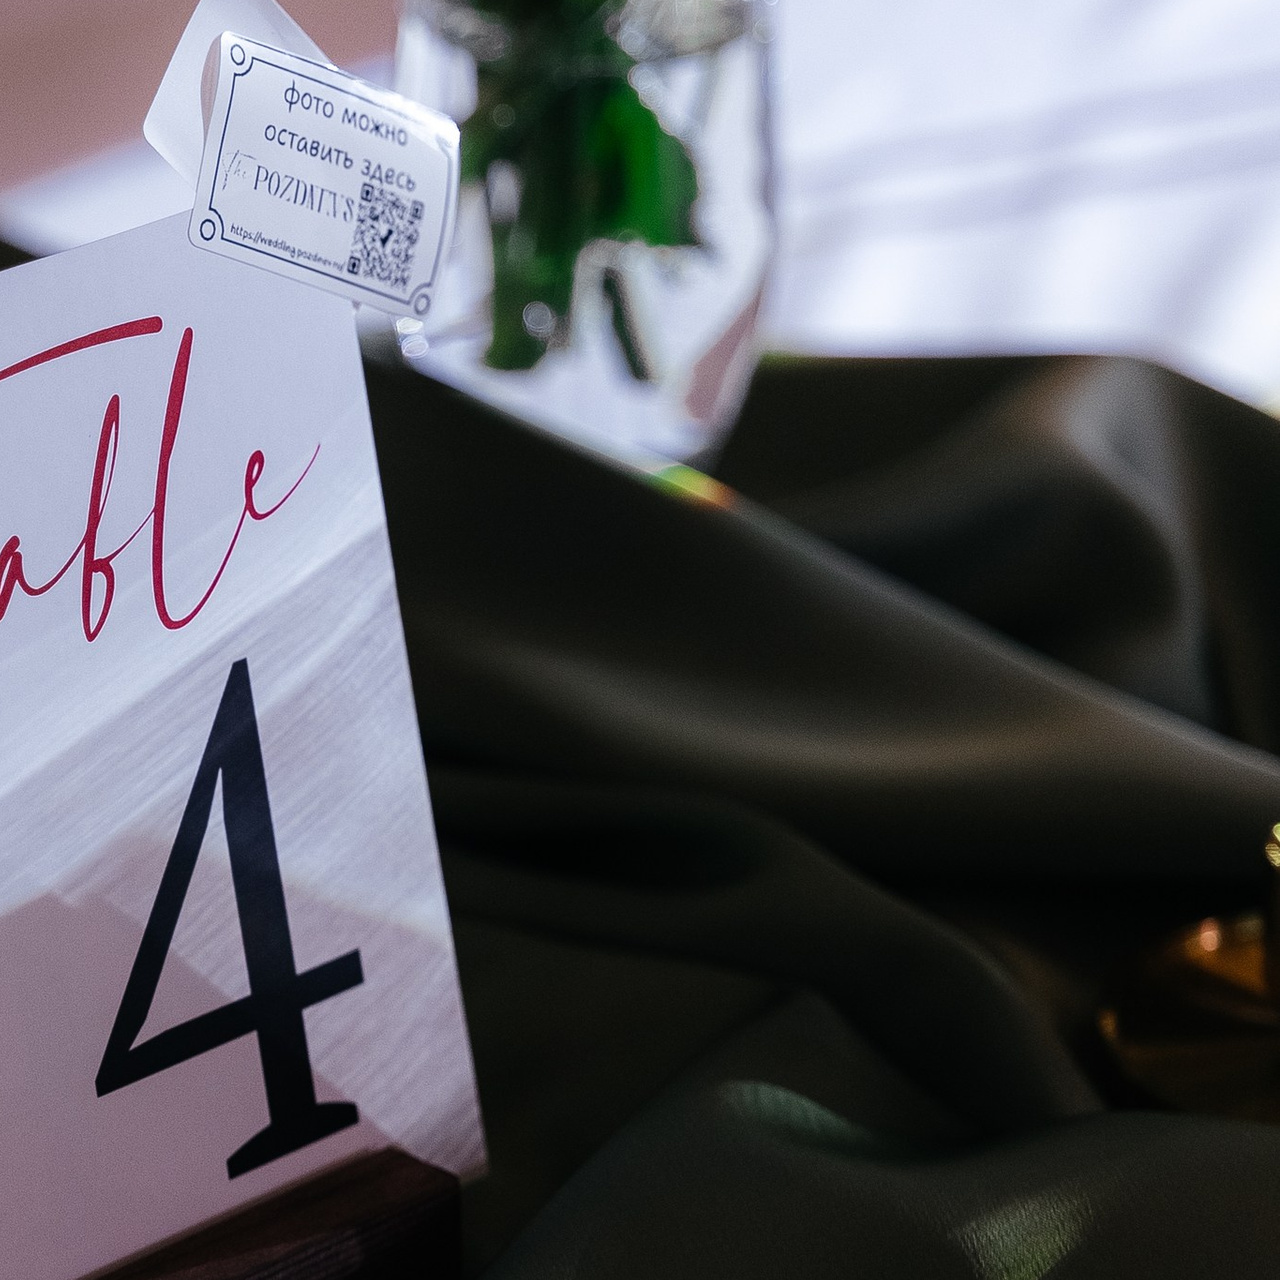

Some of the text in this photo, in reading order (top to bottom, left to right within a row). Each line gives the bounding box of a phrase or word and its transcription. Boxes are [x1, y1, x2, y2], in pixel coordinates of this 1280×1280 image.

[283, 79, 408, 147] фото можно
[264, 124, 417, 193] оставить здесь
[95, 658, 364, 1180] 4
